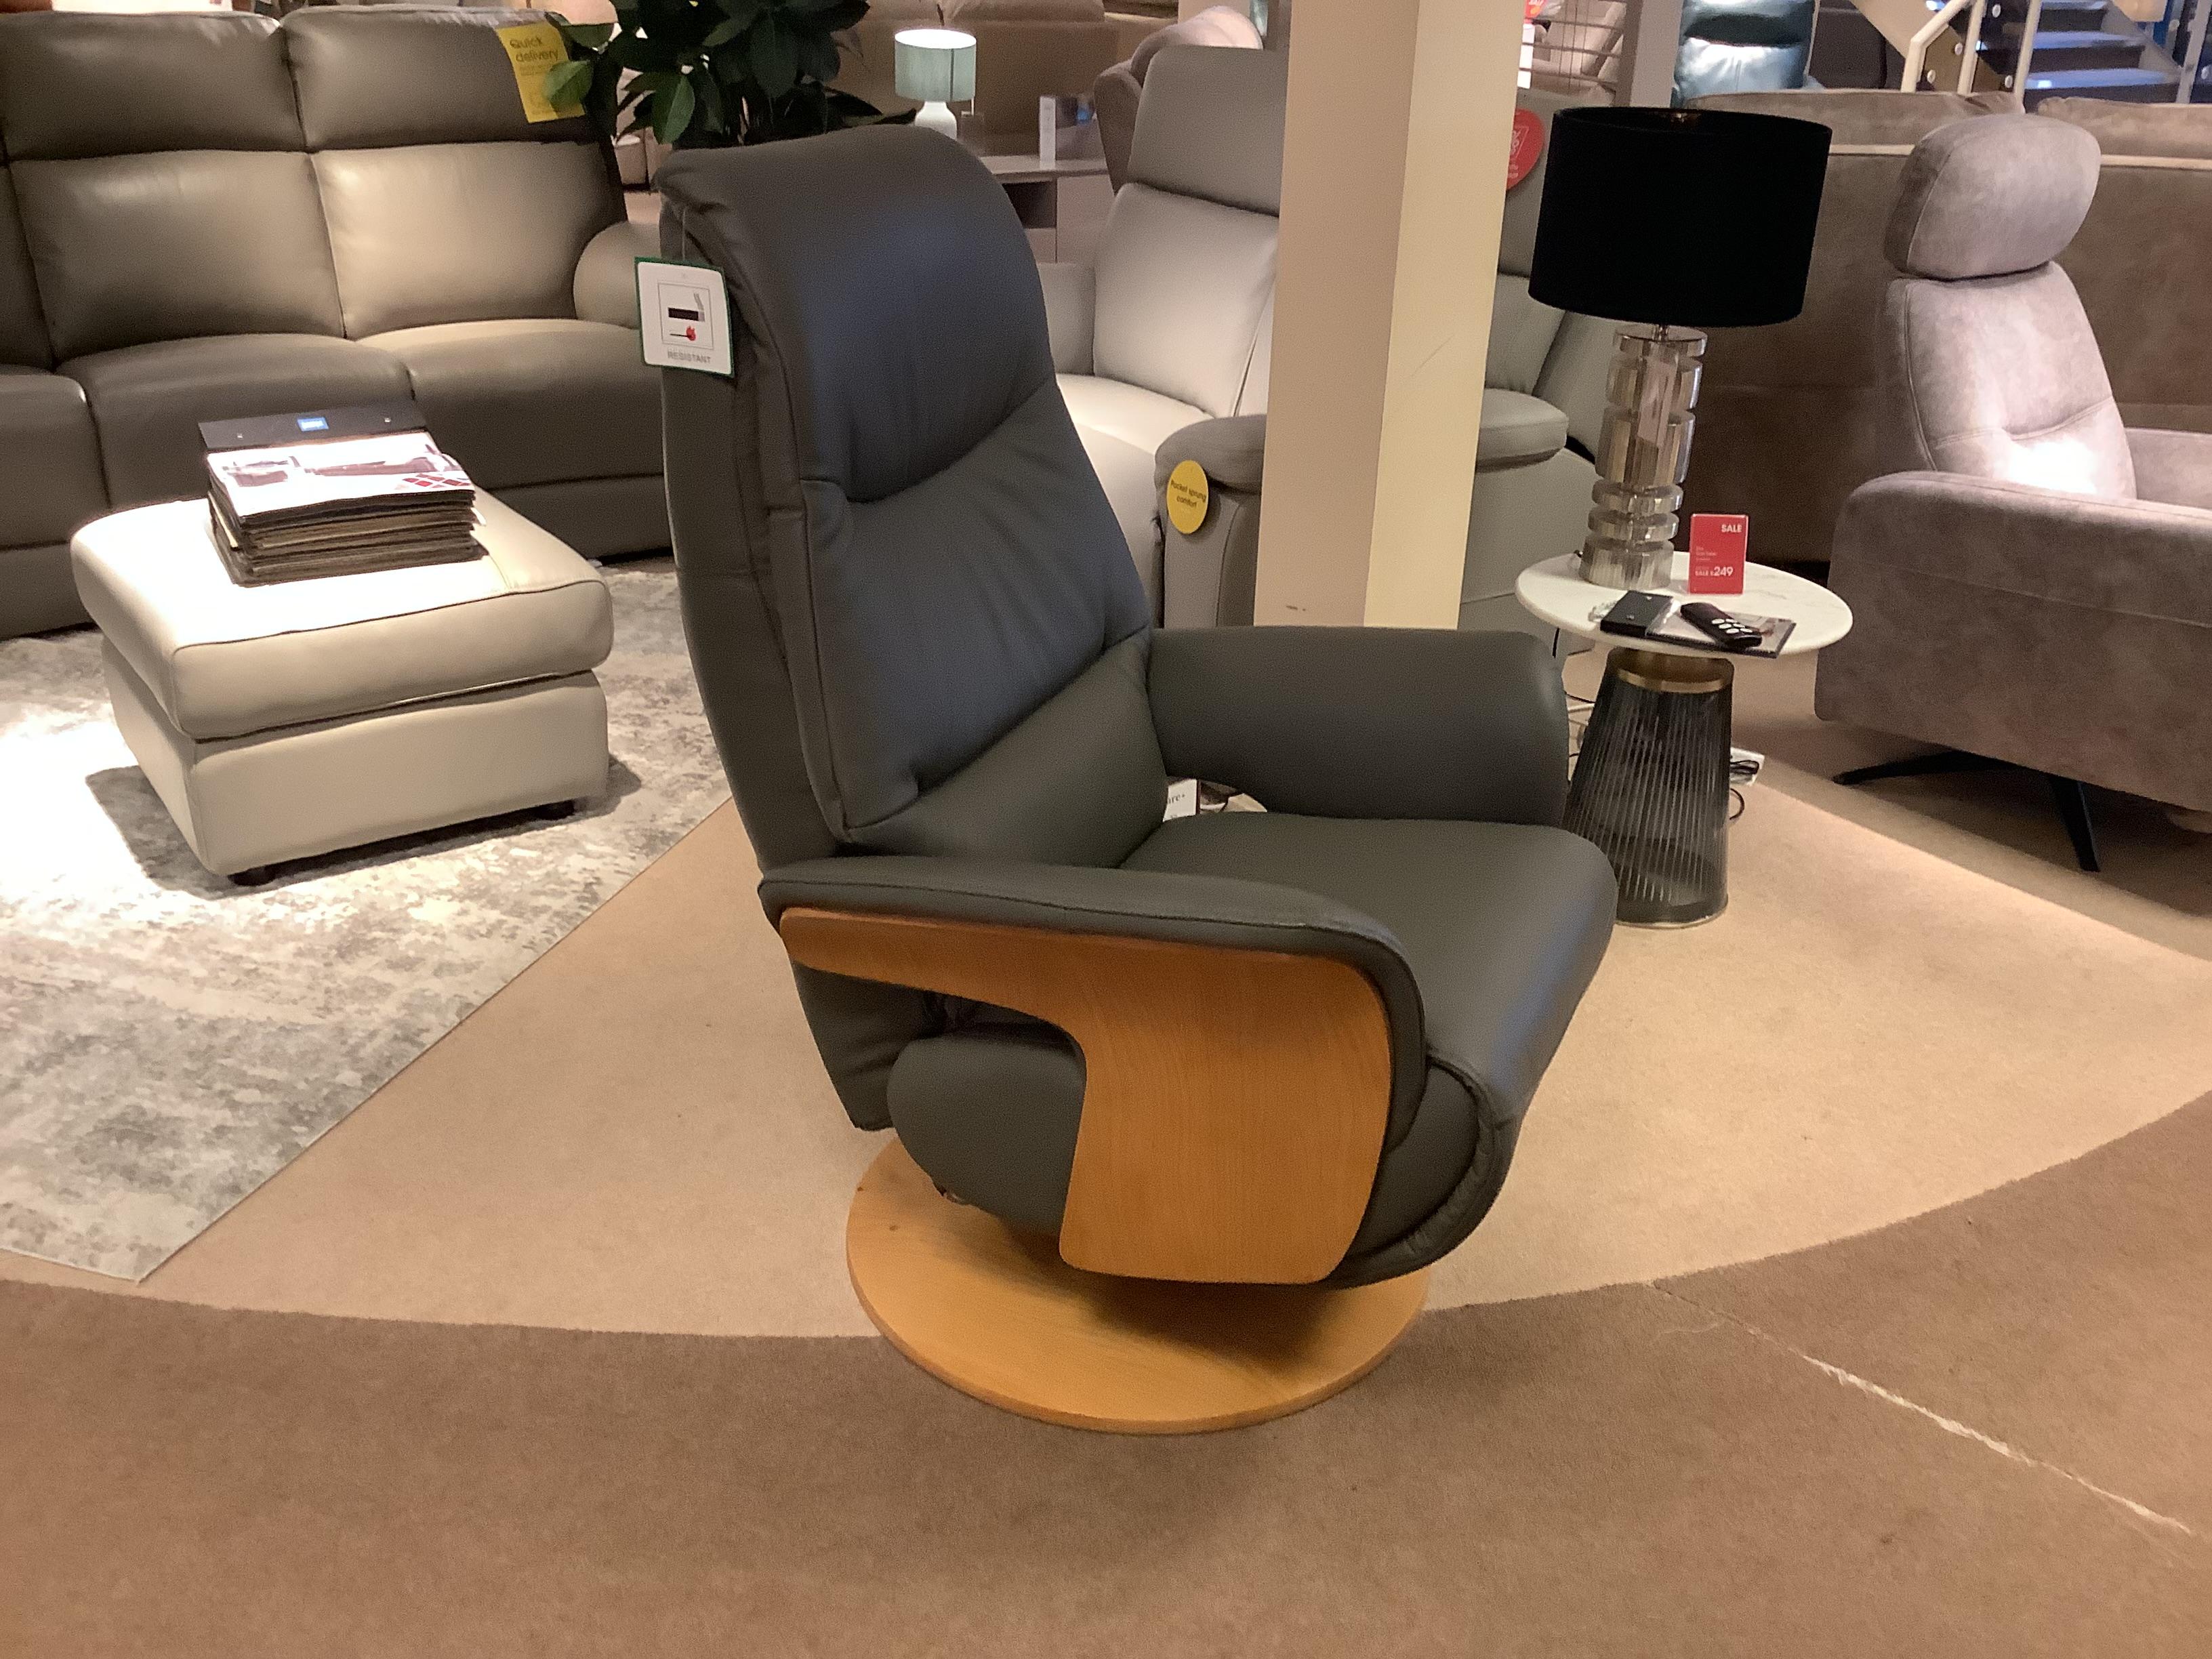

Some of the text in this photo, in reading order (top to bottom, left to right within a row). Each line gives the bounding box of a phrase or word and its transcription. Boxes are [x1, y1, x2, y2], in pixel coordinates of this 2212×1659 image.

[510, 36, 542, 49] Quick
[515, 49, 558, 62] delivery
[668, 350, 711, 364] RESISTANT
[1721, 524, 1742, 533] SALE
